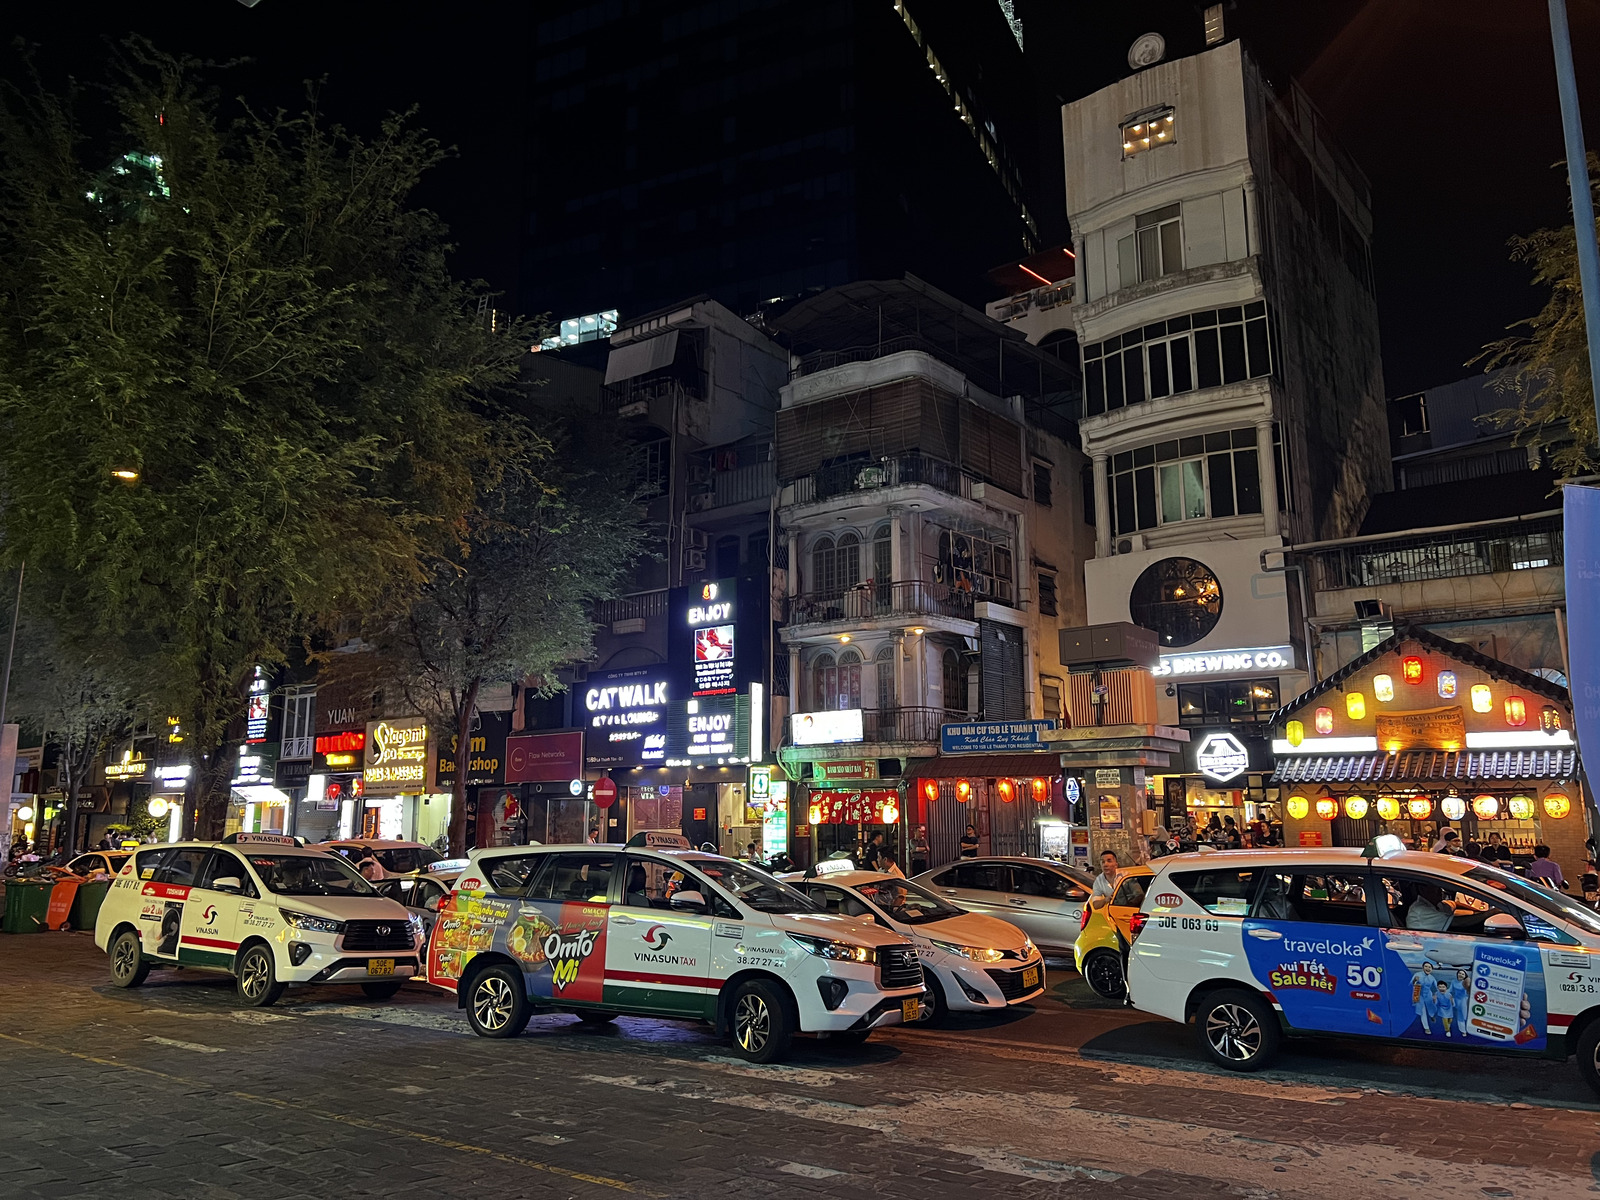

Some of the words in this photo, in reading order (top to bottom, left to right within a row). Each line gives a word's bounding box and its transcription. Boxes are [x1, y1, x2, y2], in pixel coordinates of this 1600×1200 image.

[688, 602, 731, 623] ENJOY
[1173, 654, 1252, 674] BREWING
[1254, 651, 1288, 668] CO.
[585, 681, 667, 711] CATWALK
[327, 707, 355, 725] YUAN
[592, 714, 613, 727] KTV
[621, 711, 659, 725] LOUNGE
[688, 714, 732, 733] ENJOY
[384, 724, 427, 747] Nagomi
[947, 727, 961, 736] KHU
[961, 726, 975, 736] DÂN
[976, 725, 987, 735] CƯ
[988, 725, 1000, 734] 15B
[528, 751, 541, 760] Flow
[541, 749, 566, 759] Networks
[166, 887, 186, 897] TOSHIBA
[1156, 896, 1181, 906] 18174
[150, 904, 156, 915] 2
[582, 907, 607, 915] OMACHI
[195, 926, 219, 936] VINASUN
[1158, 916, 1177, 929] 50E
[1181, 917, 1201, 930] 063
[1205, 919, 1219, 932] 69
[544, 929, 593, 960] Omto
[1283, 937, 1363, 957] traveloka
[375, 959, 387, 967] 50E
[737, 956, 760, 966] 38.27
[762, 958, 772, 966] 27
[1279, 961, 1298, 972] vui
[1300, 958, 1326, 976] Tết
[1481, 952, 1516, 967] traveloka
[1271, 972, 1307, 987] Sale
[1310, 975, 1333, 991] hết
